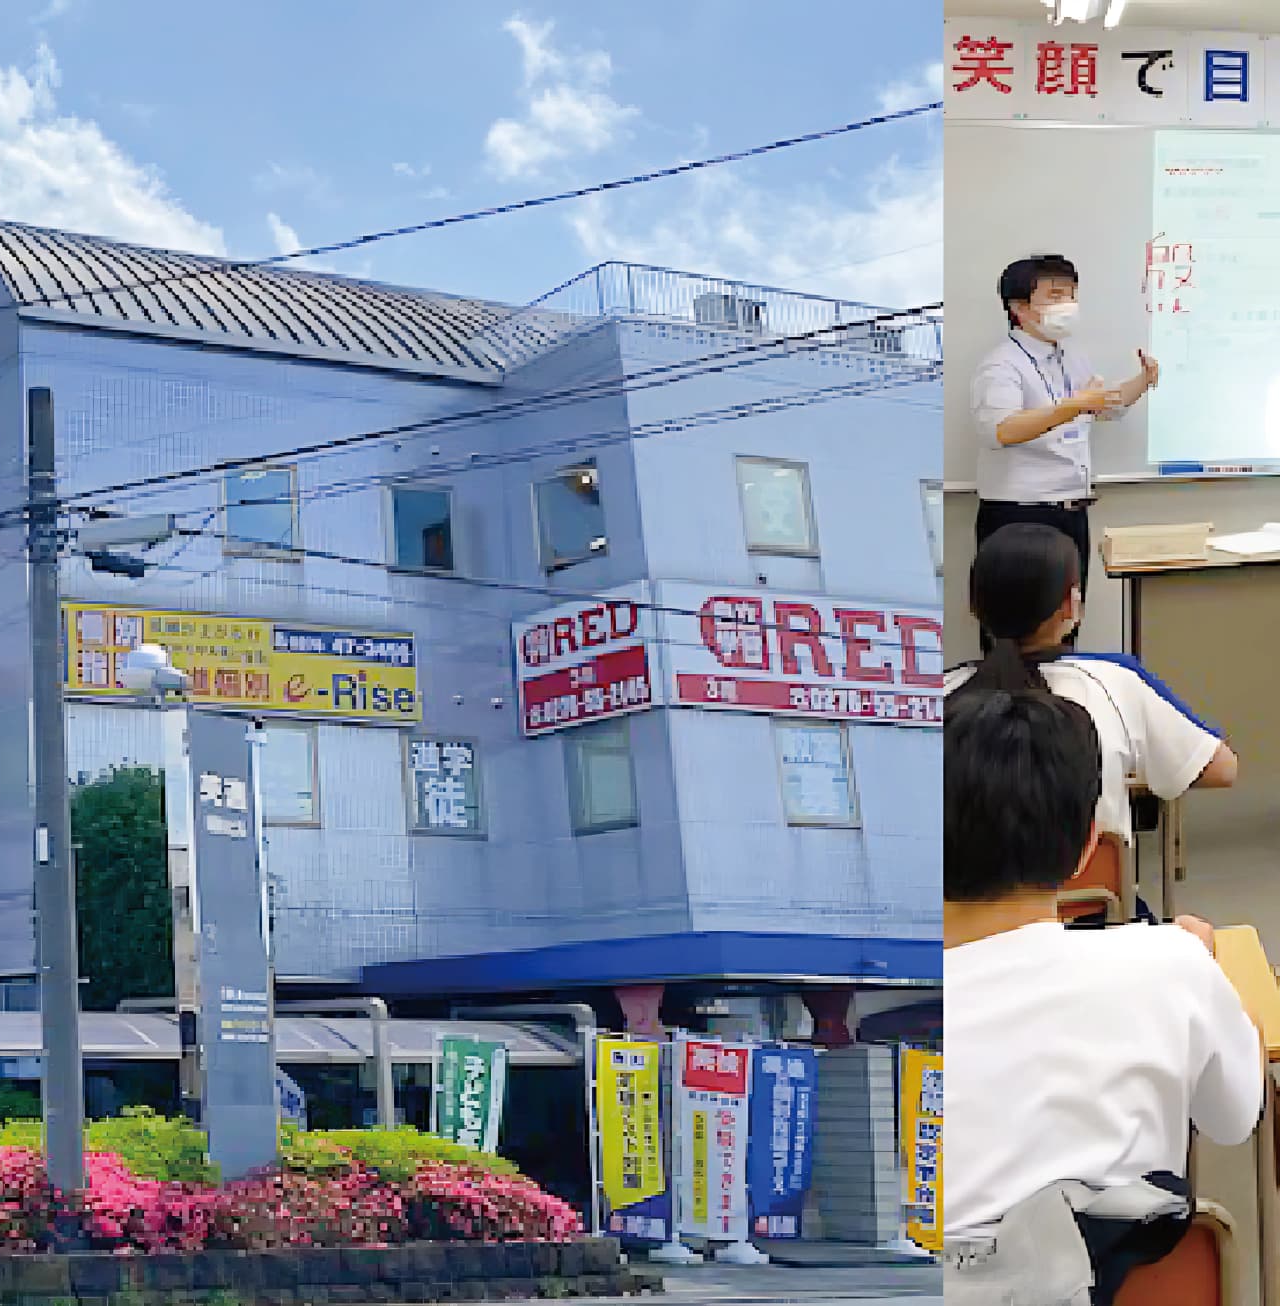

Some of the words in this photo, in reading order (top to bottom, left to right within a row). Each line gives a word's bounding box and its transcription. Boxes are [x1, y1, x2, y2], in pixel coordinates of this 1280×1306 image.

[555, 601, 638, 656] RED
[774, 602, 943, 688] RED
[284, 670, 415, 713] e-Rise
